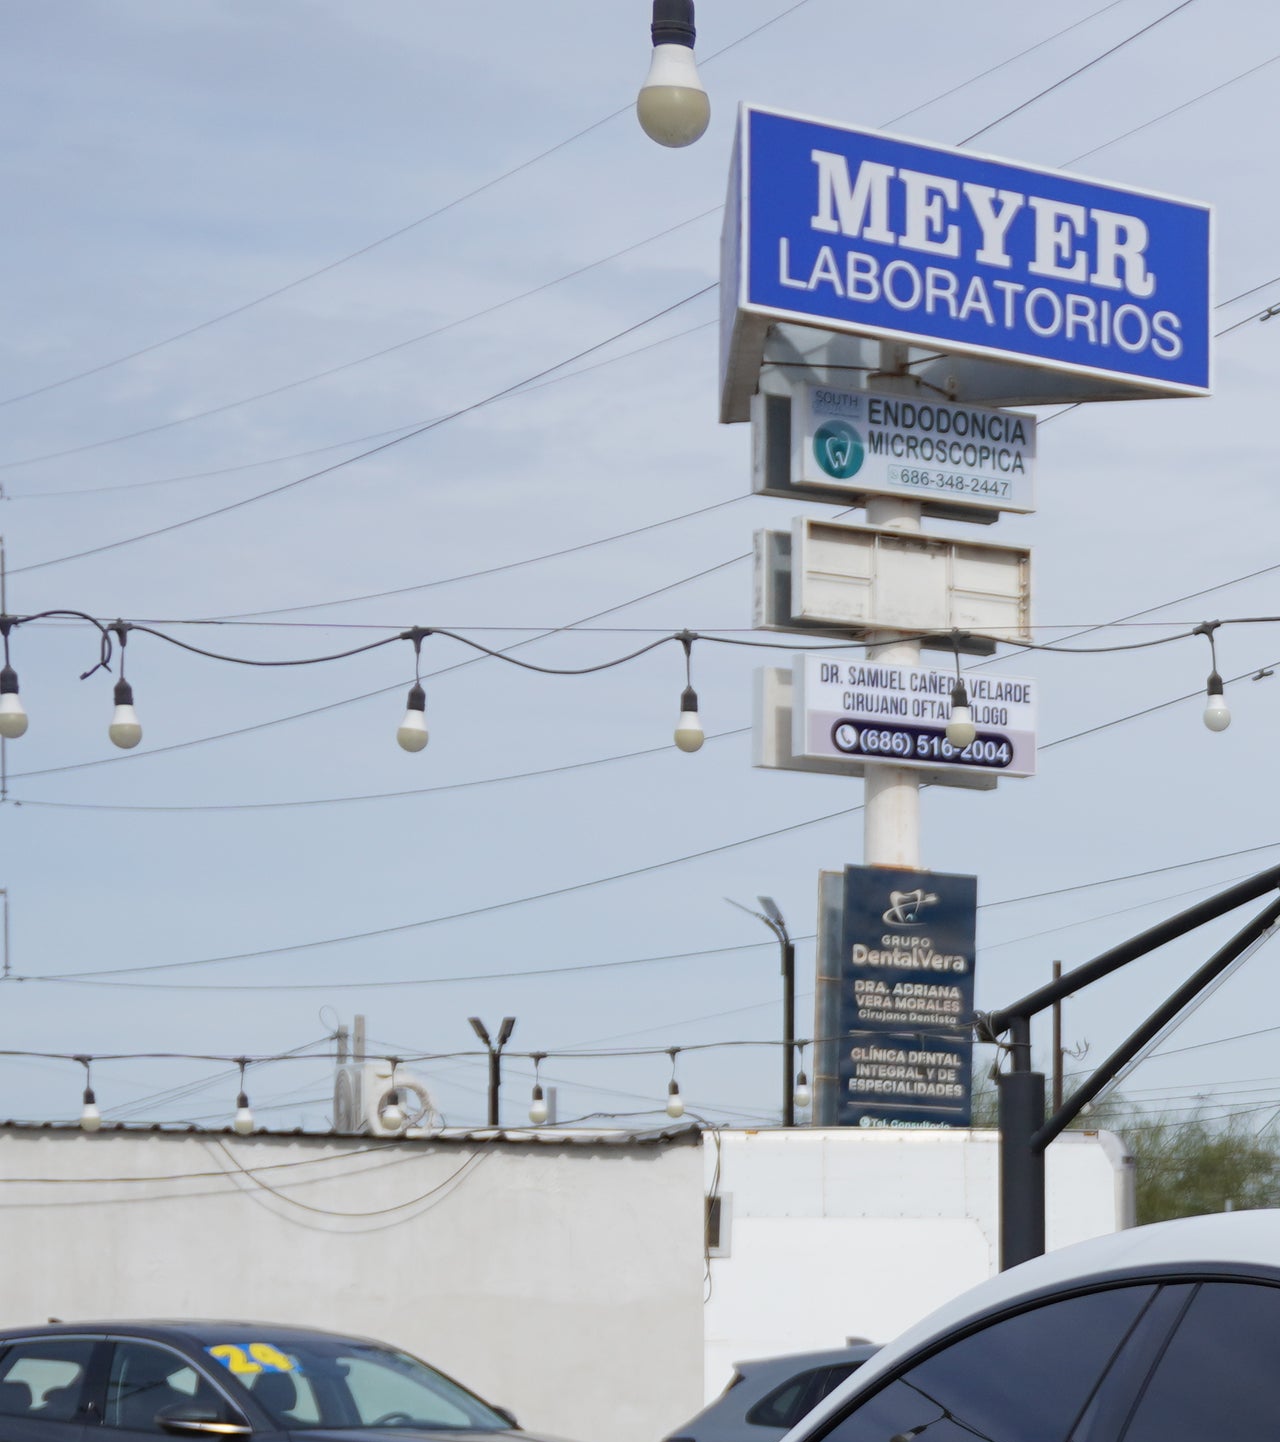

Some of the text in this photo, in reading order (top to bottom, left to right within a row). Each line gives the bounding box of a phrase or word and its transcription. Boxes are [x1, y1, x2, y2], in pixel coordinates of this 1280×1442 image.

[811, 149, 1155, 297] MEYER
[779, 237, 1182, 360] LABORATORIOS
[815, 390, 859, 408] SOUTH
[868, 398, 1026, 446] ENDODONCIA
[868, 430, 1025, 474] MICROSCOPICA
[901, 469, 1009, 496] 686-348-2447
[820, 662, 843, 685] DR.
[848, 666, 905, 691] SAMUEL
[970, 679, 1031, 703] VELARDE
[843, 691, 1008, 726] CIRUJANO OFTALÓLOGO
[859, 728, 1009, 762] (686) 516-2004
[881, 934, 931, 948] GRUPO
[852, 944, 966, 971] DentalVera
[854, 979, 960, 999] DRA. ADRIANA
[856, 994, 960, 1013] VERA MORALES
[909, 1011, 957, 1025] Dentista
[851, 1045, 961, 1067] CLÍNICA DENTAL
[856, 1063, 955, 1082] INTEGRAL Y DE
[849, 1078, 962, 1097] ESPECIALIDADES
